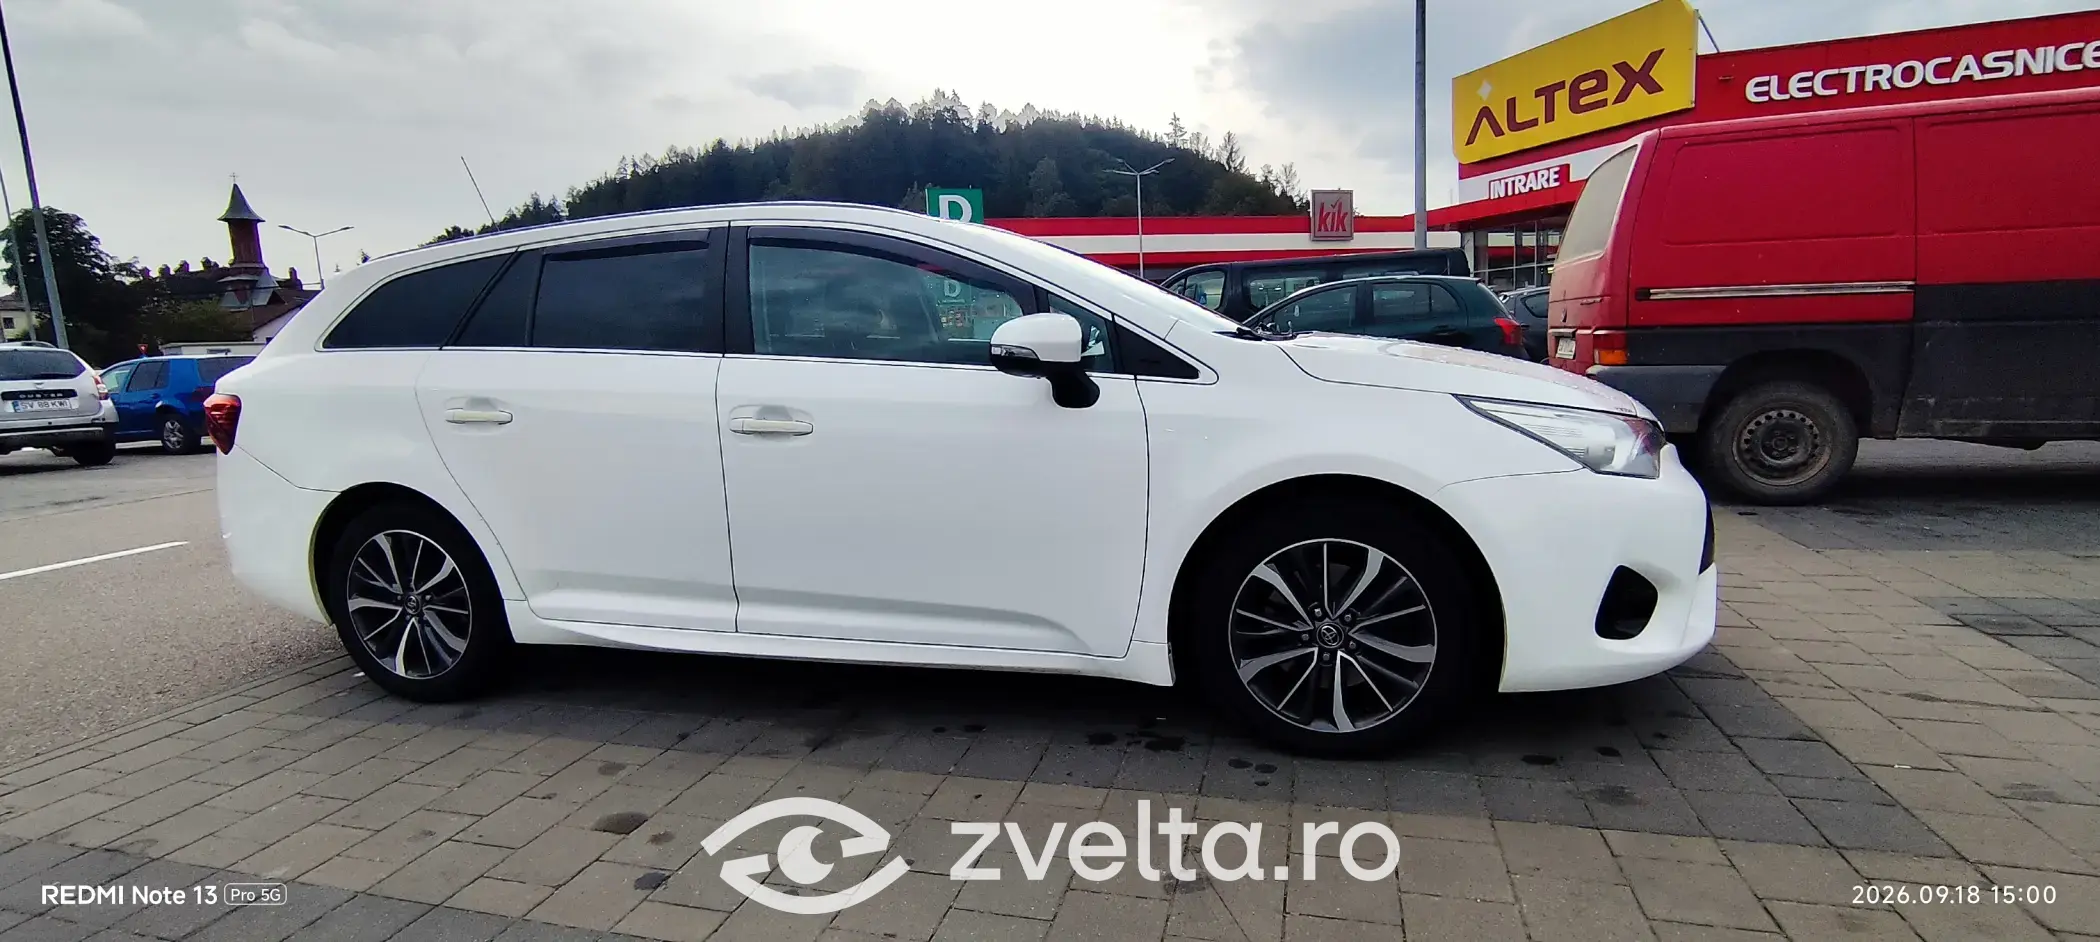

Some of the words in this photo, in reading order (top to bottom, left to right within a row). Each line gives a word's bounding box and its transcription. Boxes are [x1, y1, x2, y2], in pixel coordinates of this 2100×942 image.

[1490, 166, 1561, 200] INTRARE
[938, 194, 972, 223] D
[943, 279, 961, 297] D
